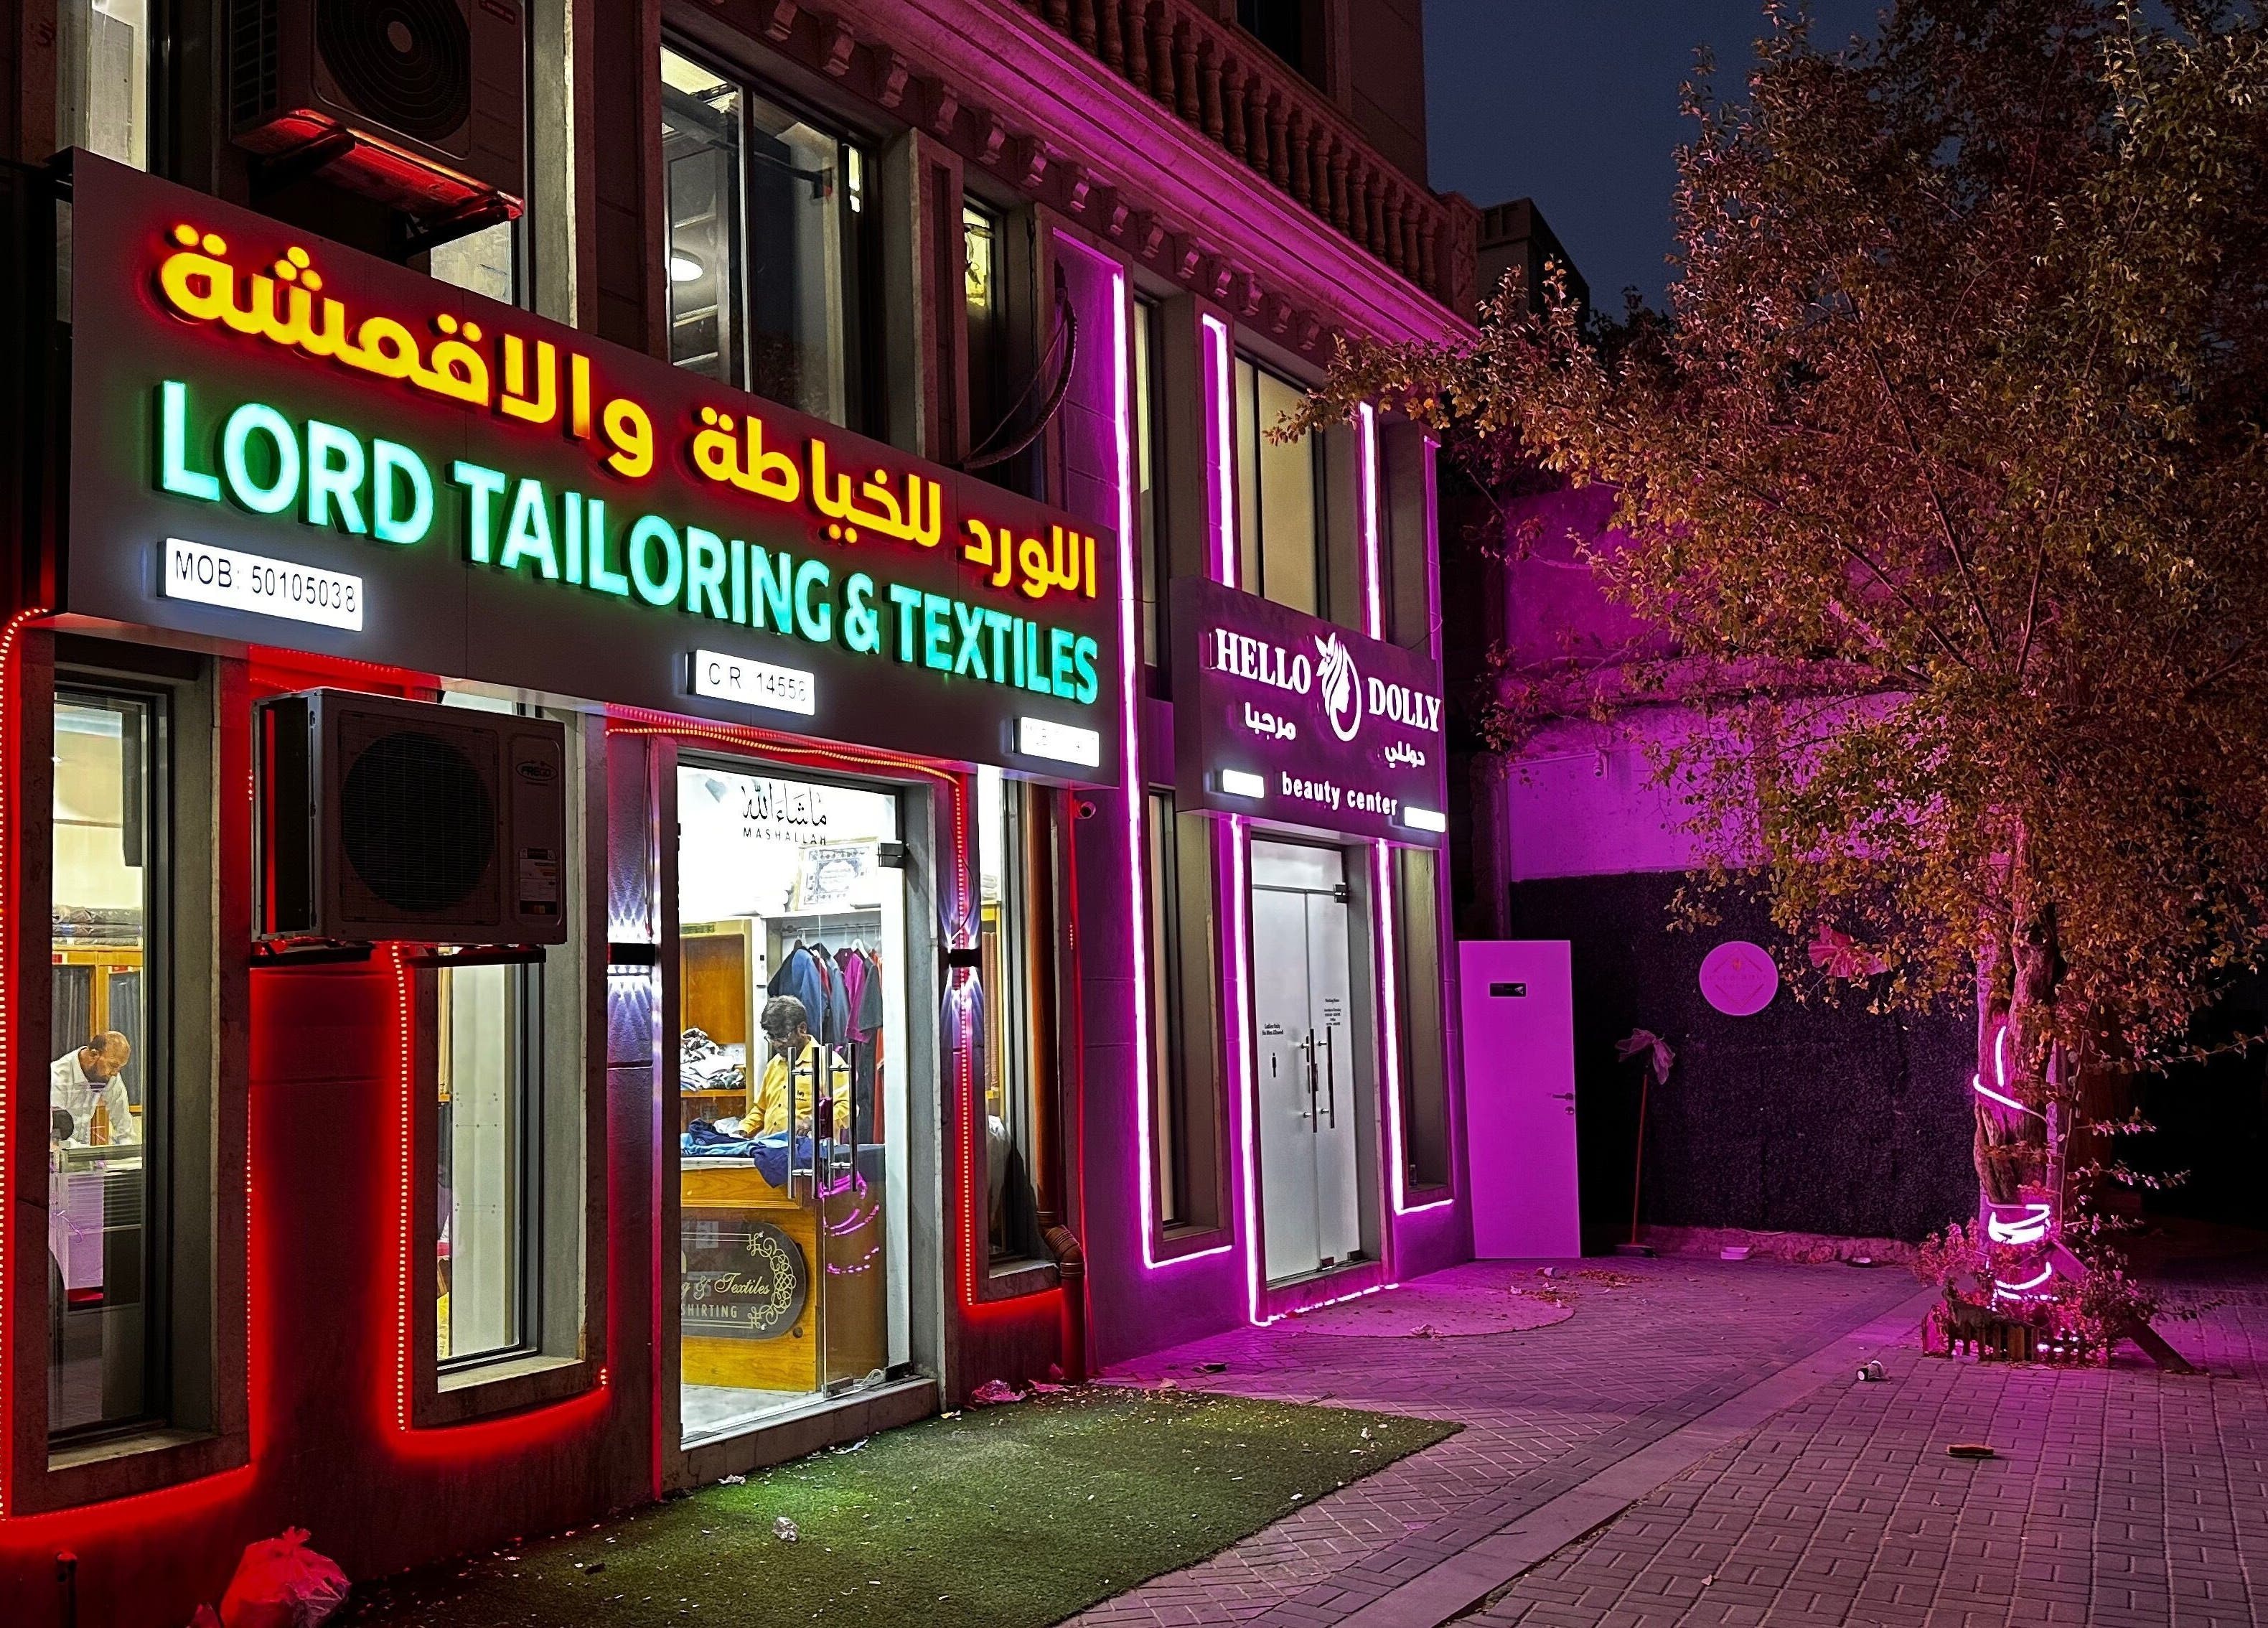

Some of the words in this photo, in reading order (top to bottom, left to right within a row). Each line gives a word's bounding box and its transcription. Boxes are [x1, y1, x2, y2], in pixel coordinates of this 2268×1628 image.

[693, 406, 942, 548] للخياطة
[163, 380, 434, 546] LORD
[454, 460, 832, 642] TAILORING
[844, 572, 881, 655] &
[890, 584, 1099, 705] TEXTILES
[965, 518, 1097, 599] اللورد
[252, 565, 357, 614] 50105038
[1215, 628, 1312, 695] HELLO
[1367, 676, 1442, 733] DOLLY
[1281, 770, 1341, 811] beauty
[1346, 789, 1398, 817] center
[743, 826, 828, 846] MASHALLAH
[714, 1272, 771, 1295] Textiles
